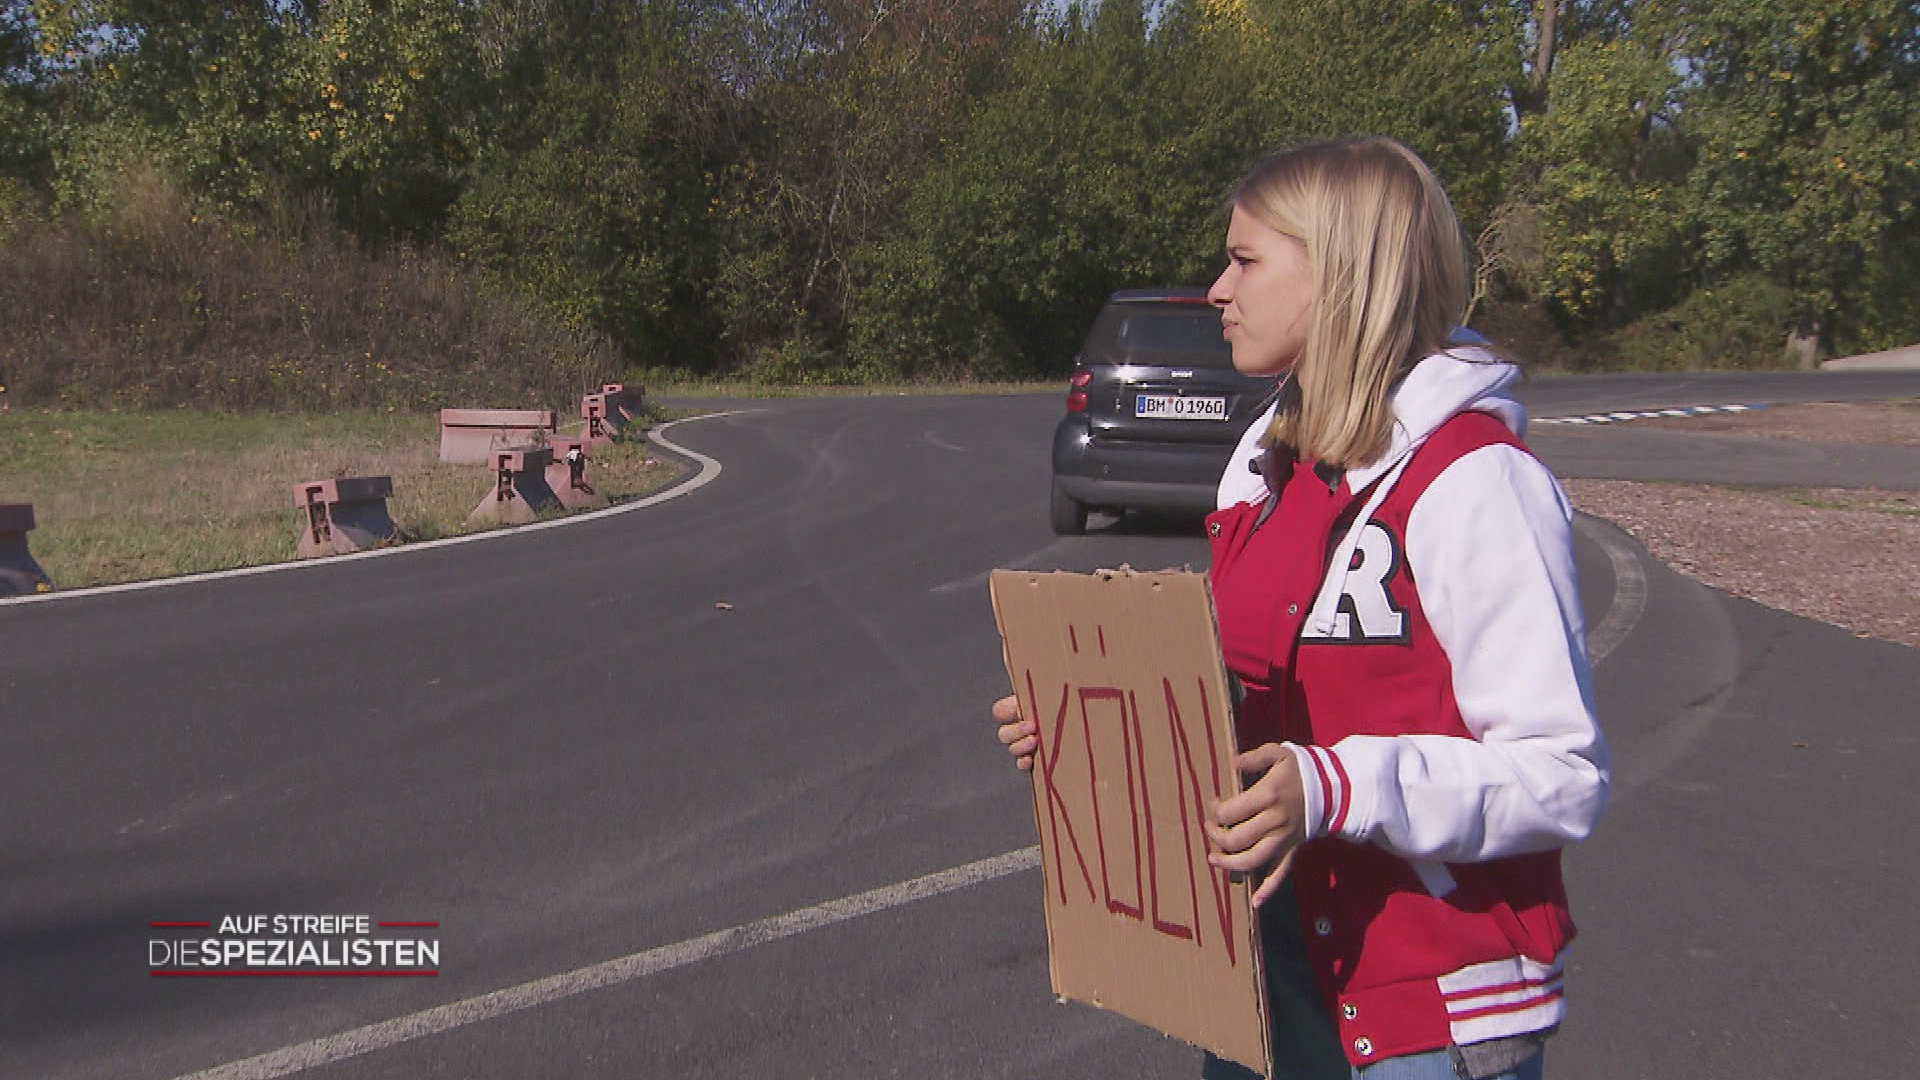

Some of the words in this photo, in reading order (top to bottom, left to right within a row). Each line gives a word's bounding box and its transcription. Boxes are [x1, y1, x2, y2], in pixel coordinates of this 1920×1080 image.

[1147, 398, 1165, 411] BM
[1187, 400, 1222, 413] 1960
[1300, 520, 1406, 642] R
[1026, 625, 1236, 967] KÖLN
